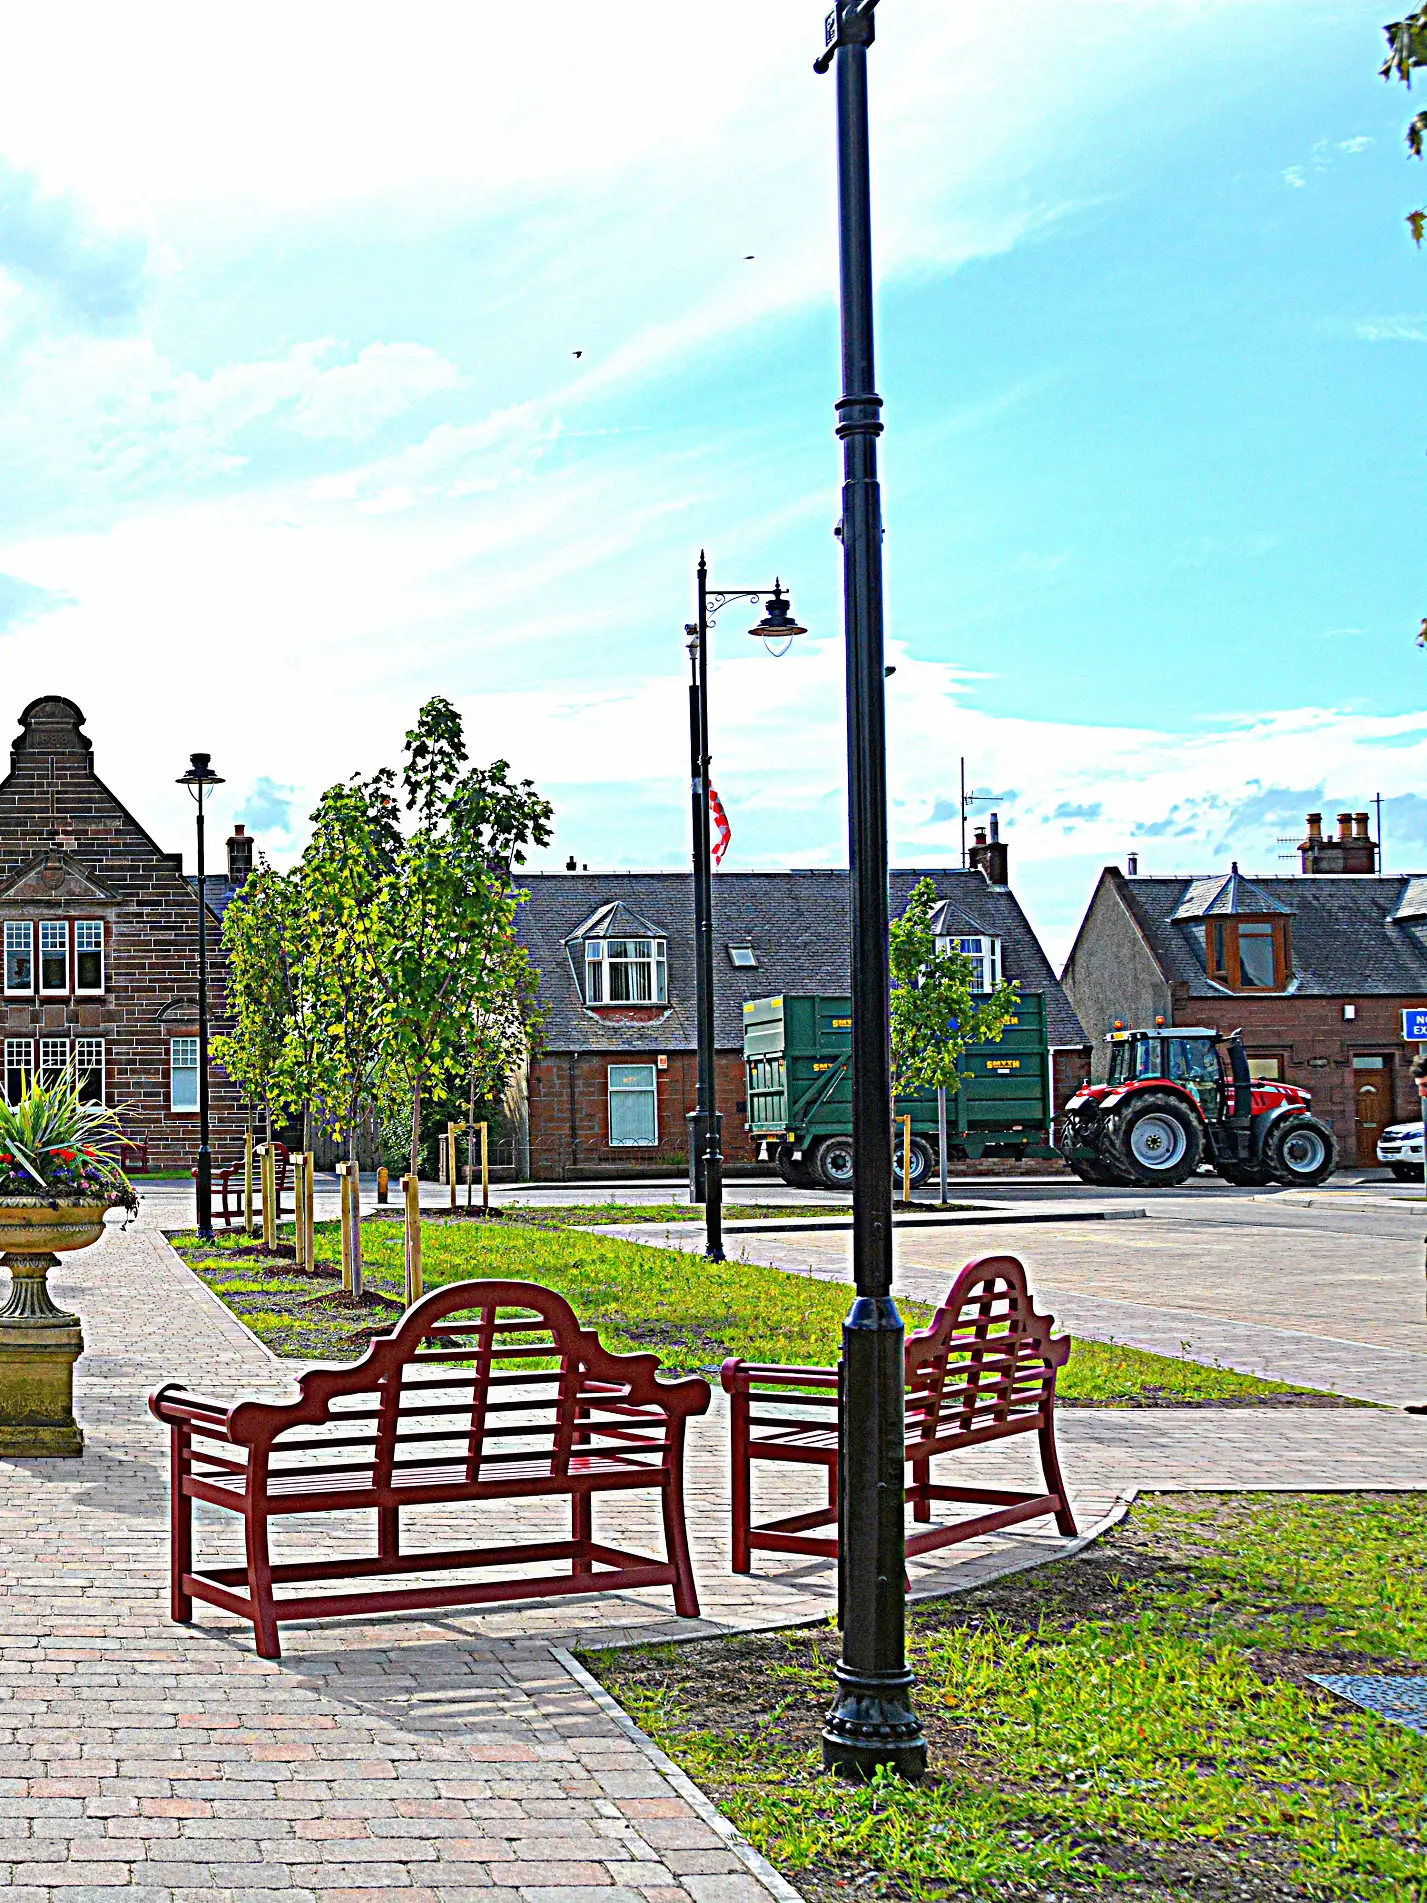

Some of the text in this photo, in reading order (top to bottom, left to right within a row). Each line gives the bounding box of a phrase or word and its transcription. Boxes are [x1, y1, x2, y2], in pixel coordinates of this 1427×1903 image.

[832, 1019, 852, 1028] SMY
[1413, 1025, 1427, 1035] EX
[813, 1063, 835, 1072] SMY
[986, 1060, 1021, 1069] SMYTH
